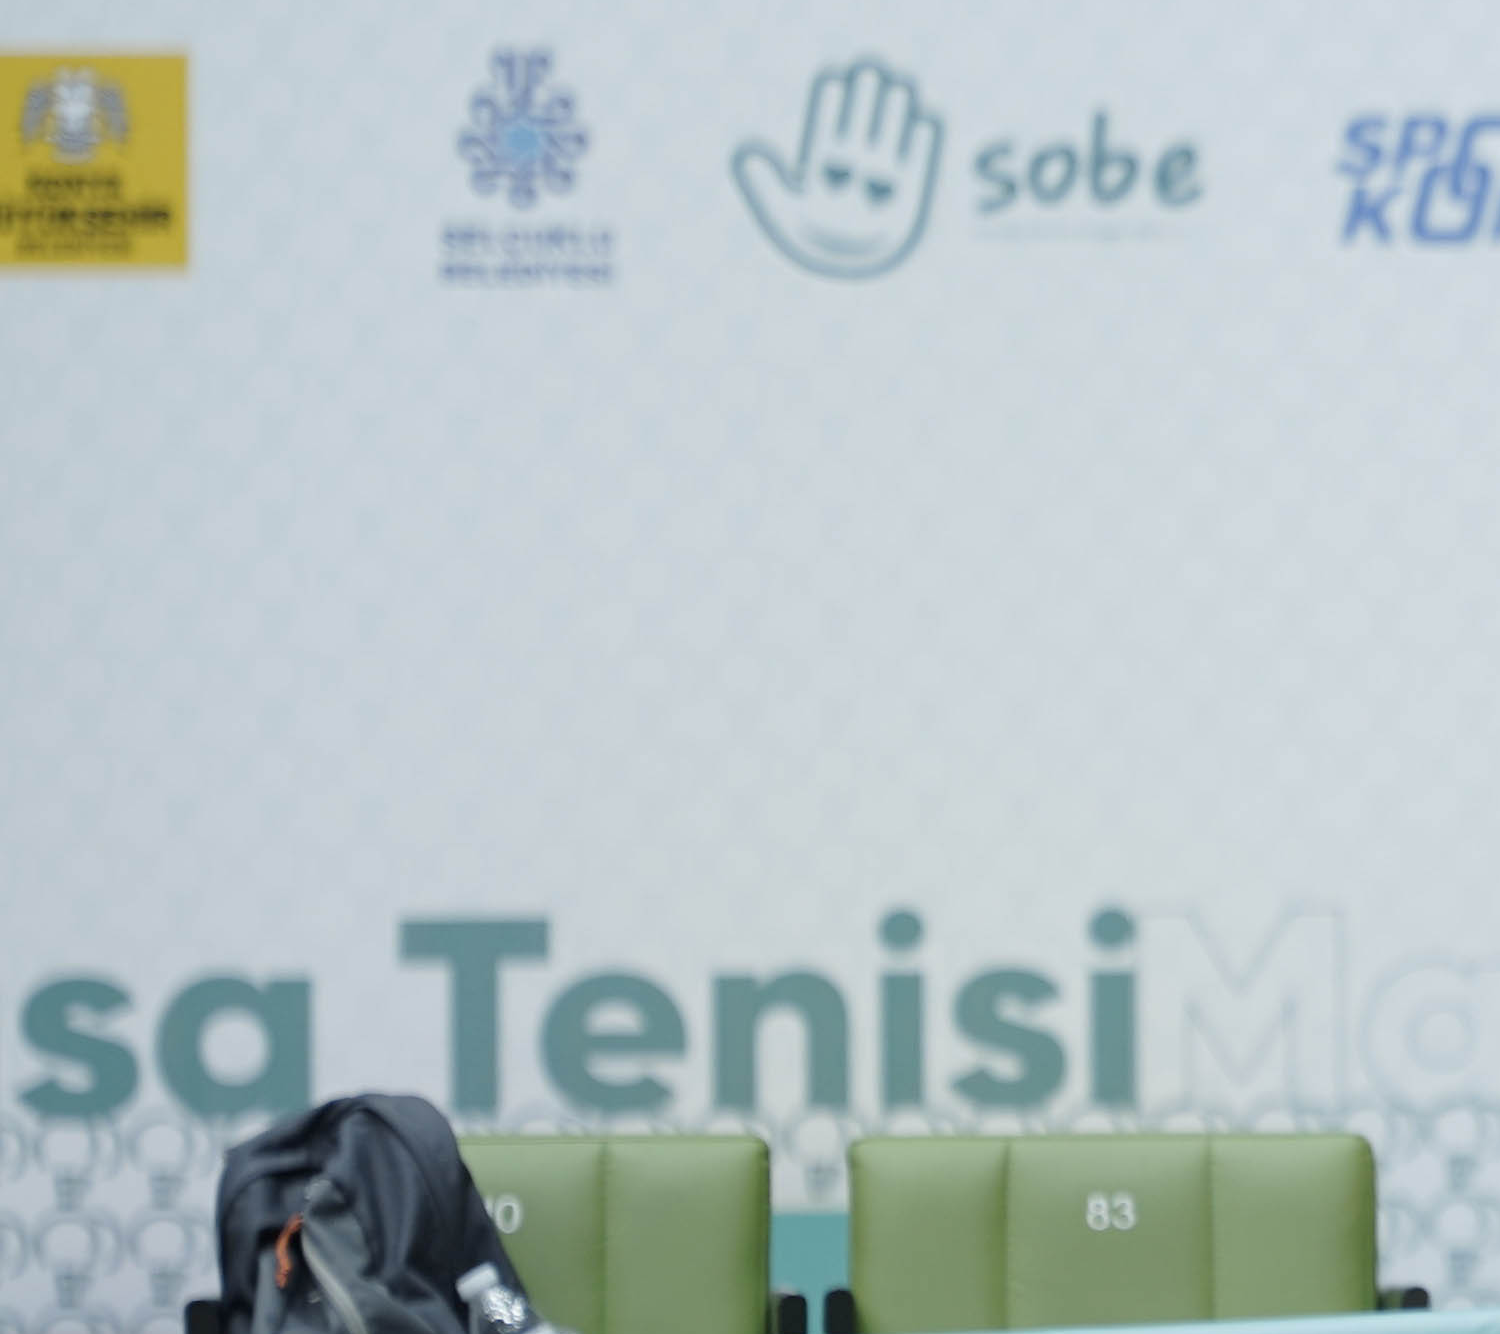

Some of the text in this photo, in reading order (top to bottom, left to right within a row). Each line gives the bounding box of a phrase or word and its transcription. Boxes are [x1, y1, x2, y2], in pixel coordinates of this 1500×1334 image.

[972, 104, 1202, 215] sobe
[17, 908, 1139, 1119] sa Tenisi
[484, 1194, 523, 1234] 0
[1087, 1192, 1137, 1231] 83
